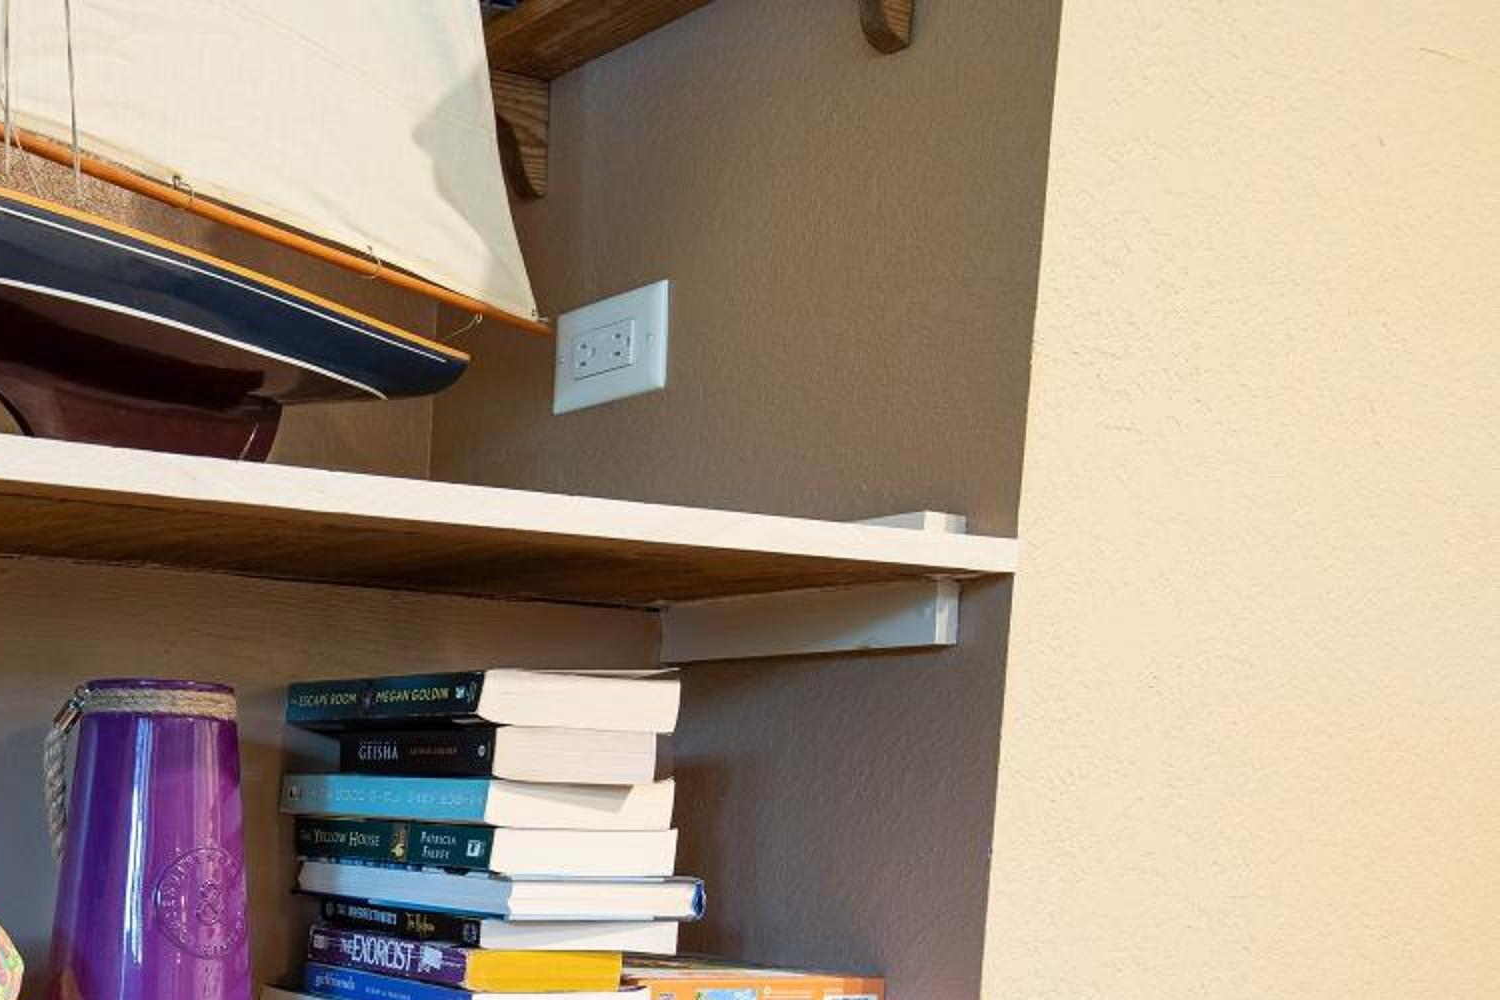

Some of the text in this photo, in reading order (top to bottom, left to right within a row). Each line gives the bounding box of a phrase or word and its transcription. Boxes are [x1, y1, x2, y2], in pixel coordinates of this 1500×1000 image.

[374, 688, 410, 704] MEGAN
[357, 744, 400, 762] GEISHA
[314, 829, 347, 845] YELLOW
[348, 831, 381, 848] HOUSE
[351, 933, 416, 973] EXORCIST
